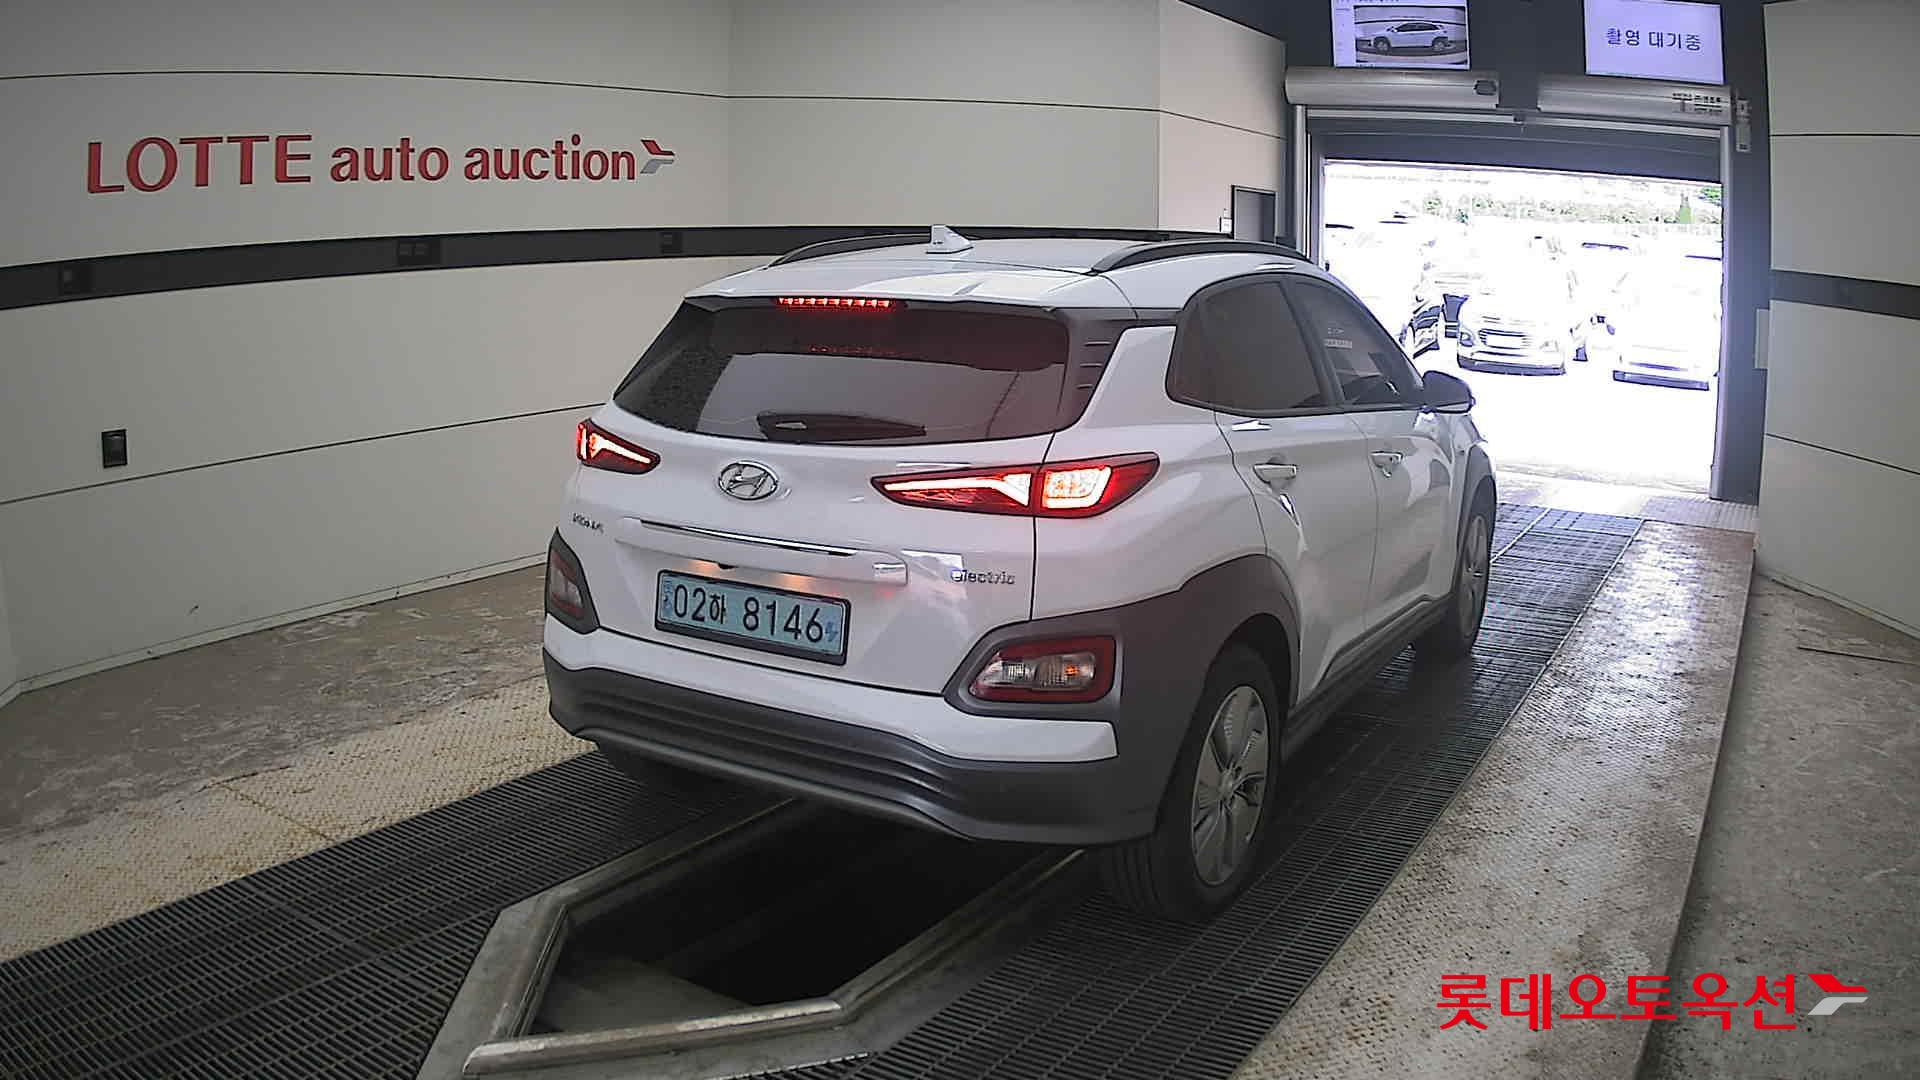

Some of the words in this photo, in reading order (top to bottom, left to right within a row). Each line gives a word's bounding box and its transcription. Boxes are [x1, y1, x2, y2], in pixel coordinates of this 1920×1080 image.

[1606, 28, 1641, 47] 촬영
[1648, 31, 1701, 51] 대기중
[87, 134, 312, 194] LOTTE
[330, 136, 449, 183] auto
[463, 133, 636, 182] auction
[674, 584, 727, 625] 02하
[743, 596, 824, 643] 8146
